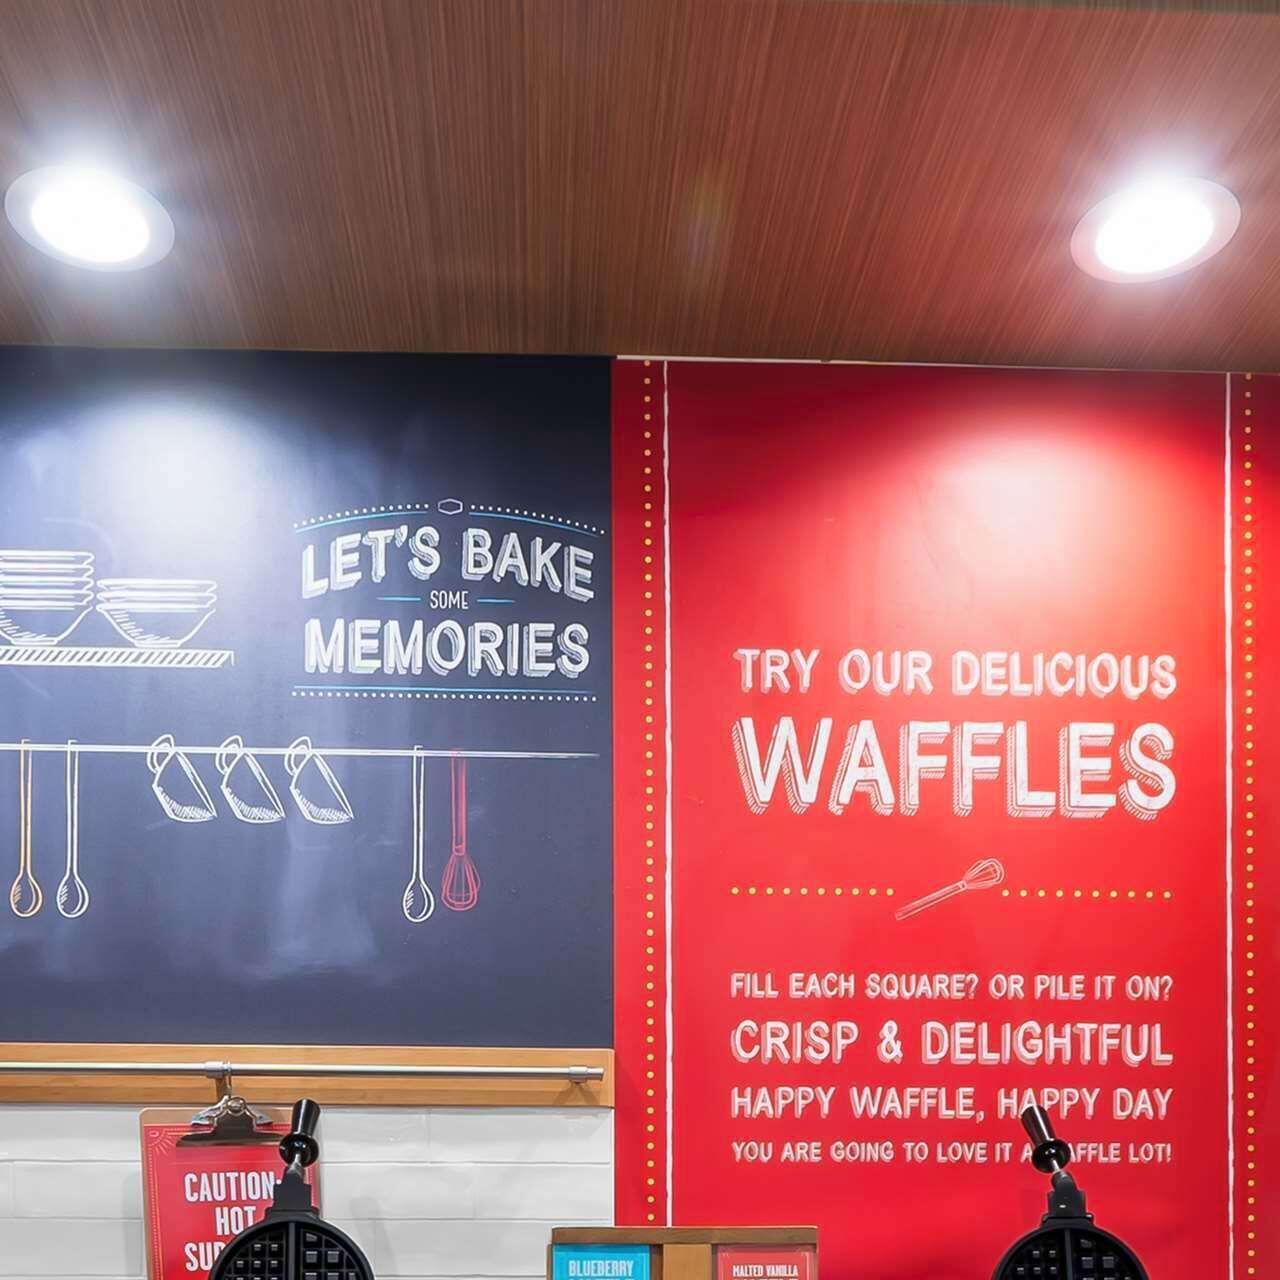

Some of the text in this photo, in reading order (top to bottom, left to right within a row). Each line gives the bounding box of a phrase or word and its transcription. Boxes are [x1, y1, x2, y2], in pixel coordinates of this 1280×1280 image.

[302, 525, 594, 602] LET'S BAKE
[430, 591, 469, 609] SOME
[304, 618, 590, 678] MEMORIES
[733, 648, 1177, 698] TRY OUR DELICIOUS
[732, 716, 1177, 821] WAFFLES
[731, 972, 1173, 1001] FILL EACH SQUARE? OR PILE IT ON?
[731, 1019, 1173, 1067] CRISP & DELIGHTFUL
[731, 1086, 1173, 1123] HAPPY WAFFLE, HAPPY DAY
[732, 1141, 772, 1163] YOU
[781, 1141, 822, 1163] ARE
[830, 1141, 894, 1163] GOING
[903, 1142, 929, 1163] TO
[936, 1142, 987, 1163] LOVE
[995, 1142, 1013, 1163] IT
[1068, 1142, 1121, 1164] AFFLE
[1128, 1142, 1172, 1164] LOT!
[215, 1206, 257, 1236] HOT
[569, 1260, 634, 1277] BLUEBERRY
[733, 1264, 799, 1277] MALTED VANILLA
